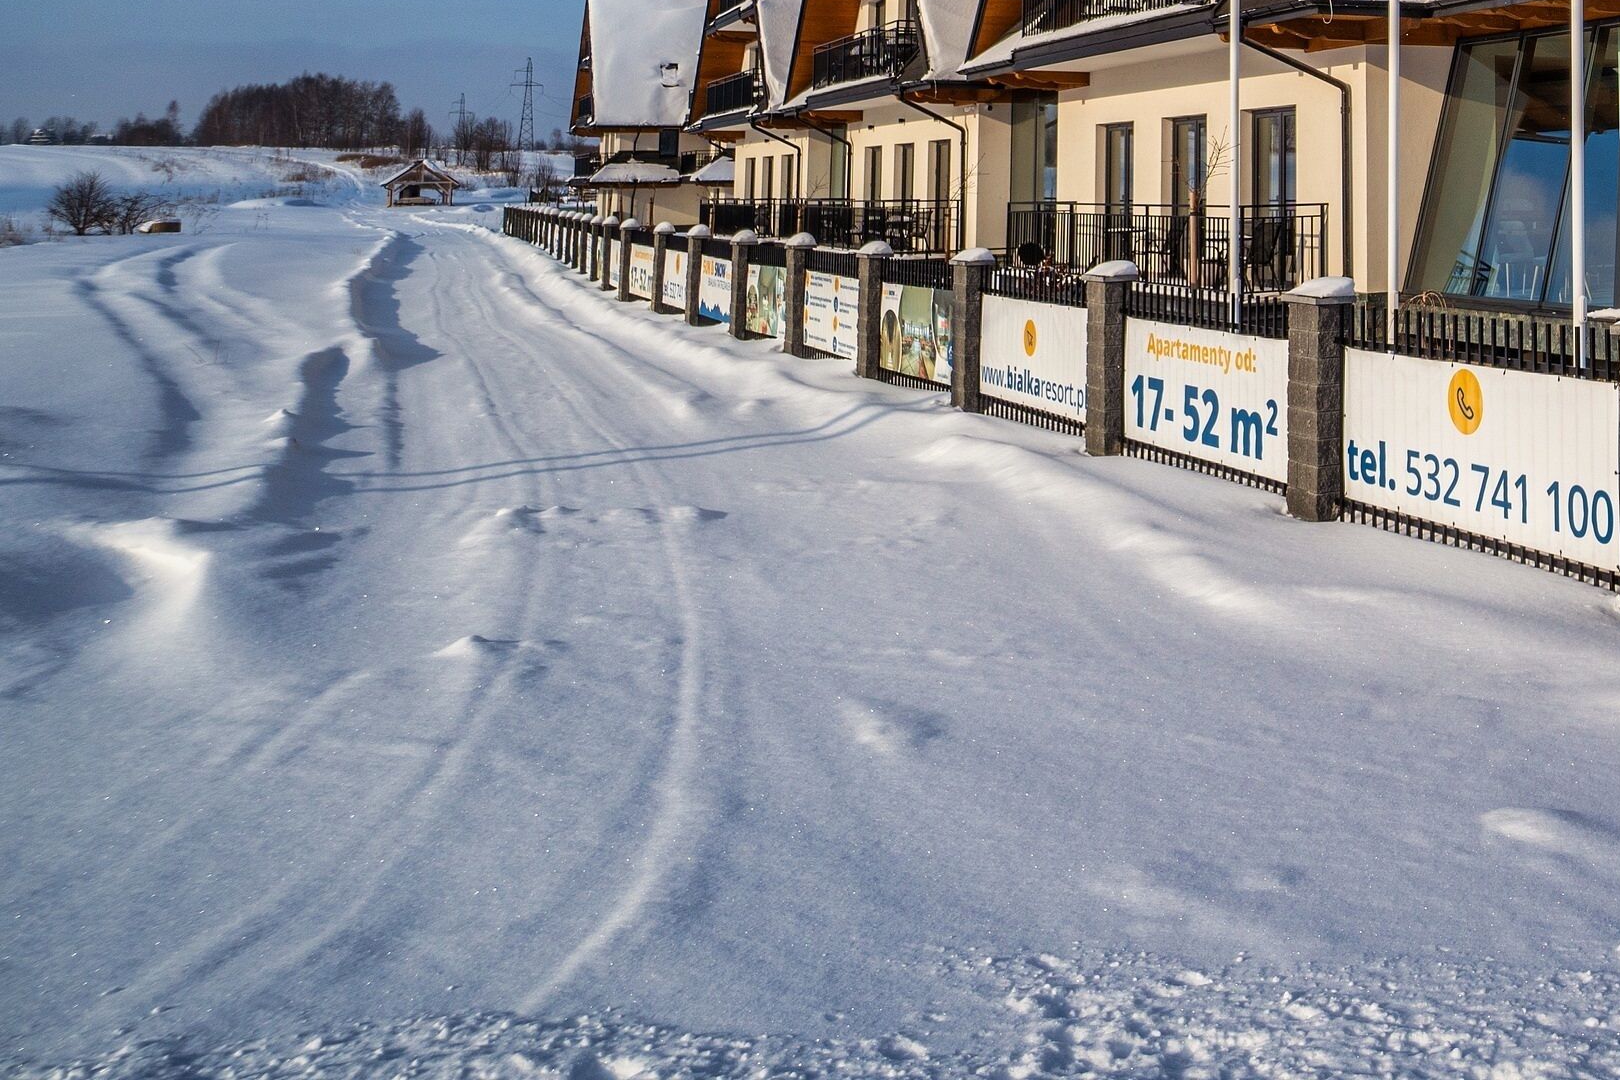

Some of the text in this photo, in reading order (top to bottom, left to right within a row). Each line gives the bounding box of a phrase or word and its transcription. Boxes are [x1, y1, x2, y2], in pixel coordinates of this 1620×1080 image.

[1146, 332, 1257, 375] Apartamenty od:
[1183, 384, 1220, 448] 52
[1347, 439, 1614, 545] tel. 532 741 100
